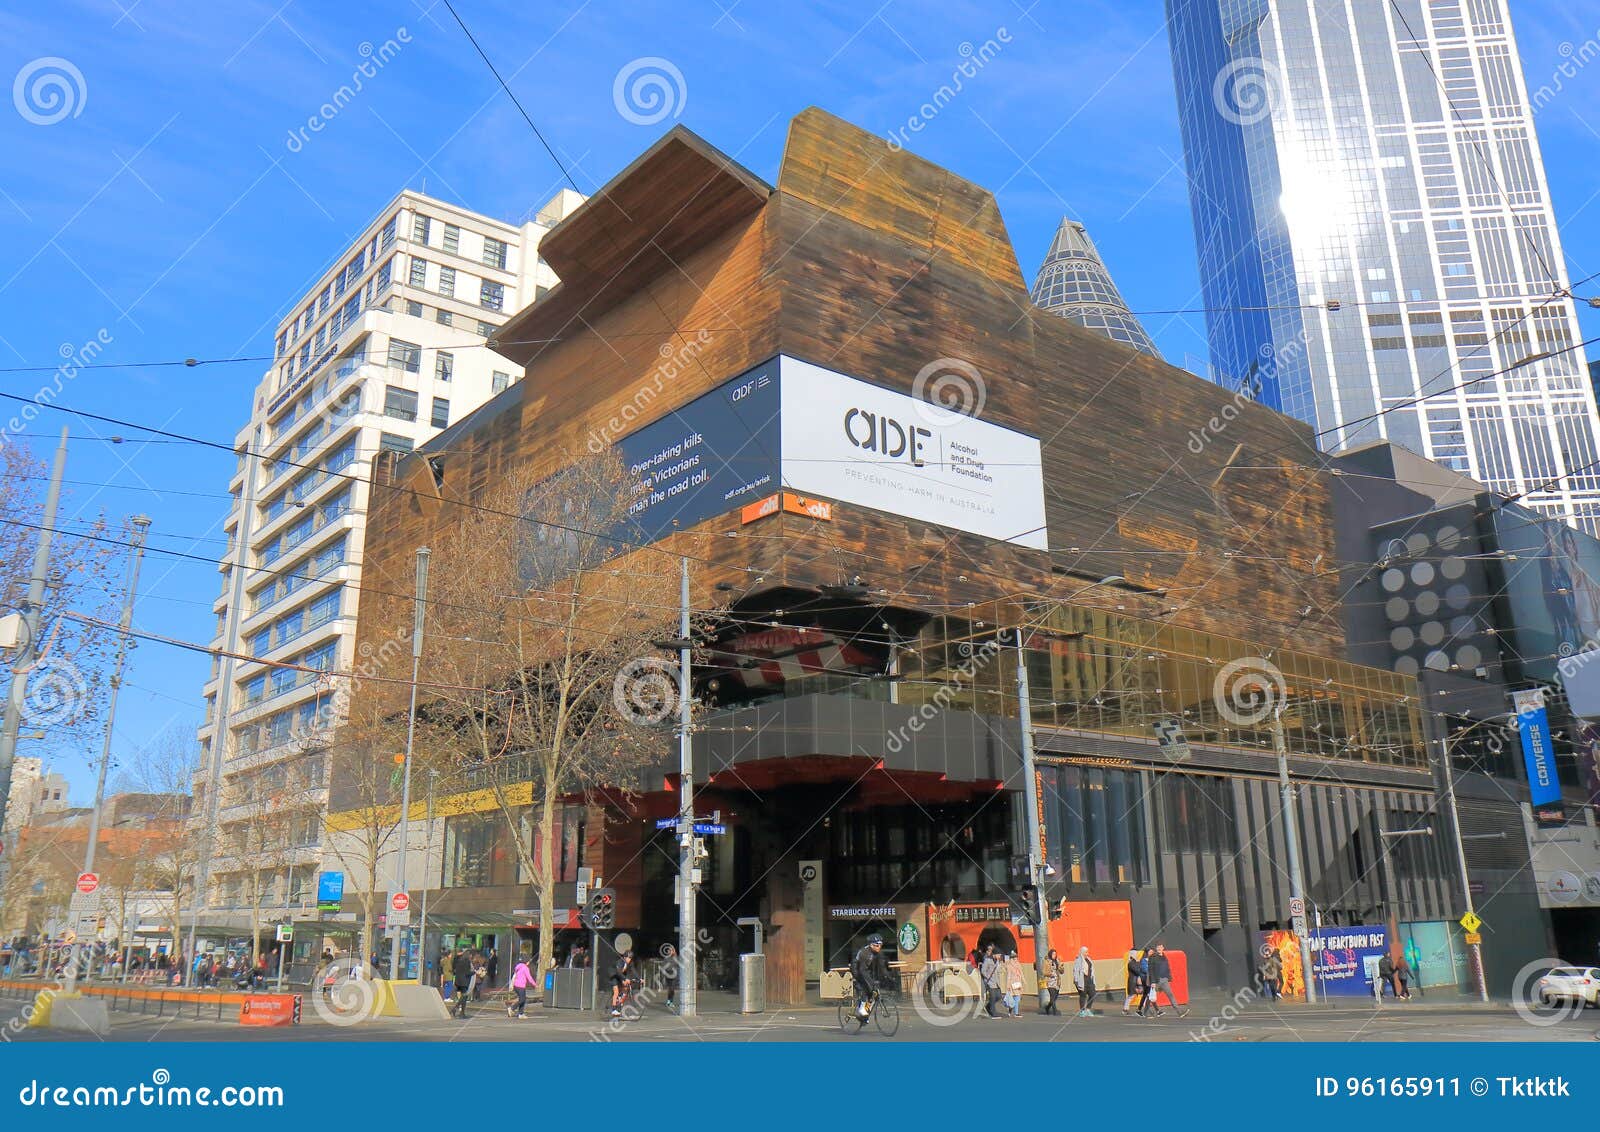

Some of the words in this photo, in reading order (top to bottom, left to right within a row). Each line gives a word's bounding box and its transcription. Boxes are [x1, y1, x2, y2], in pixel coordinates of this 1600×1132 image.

[630, 443, 681, 476] Over-taking
[683, 432, 703, 451] kills
[950, 441, 978, 456] Alcohol
[654, 454, 700, 484] Victorians
[950, 454, 965, 464] and
[966, 457, 985, 471] Drug
[951, 465, 993, 483] Foundation
[650, 491, 665, 505] the
[667, 477, 689, 497] road
[691, 467, 711, 485] toll.
[844, 468, 904, 490] PREVENTING
[908, 486, 933, 499] HARM
[949, 497, 995, 515] AUSTRALIA
[1529, 724, 1550, 787] CONVERSE
[831, 908, 870, 917] STARBUCKS
[871, 907, 896, 916] COFFEE
[1327, 934, 1368, 951] HEARTBURN
[1369, 933, 1385, 948] FAST
